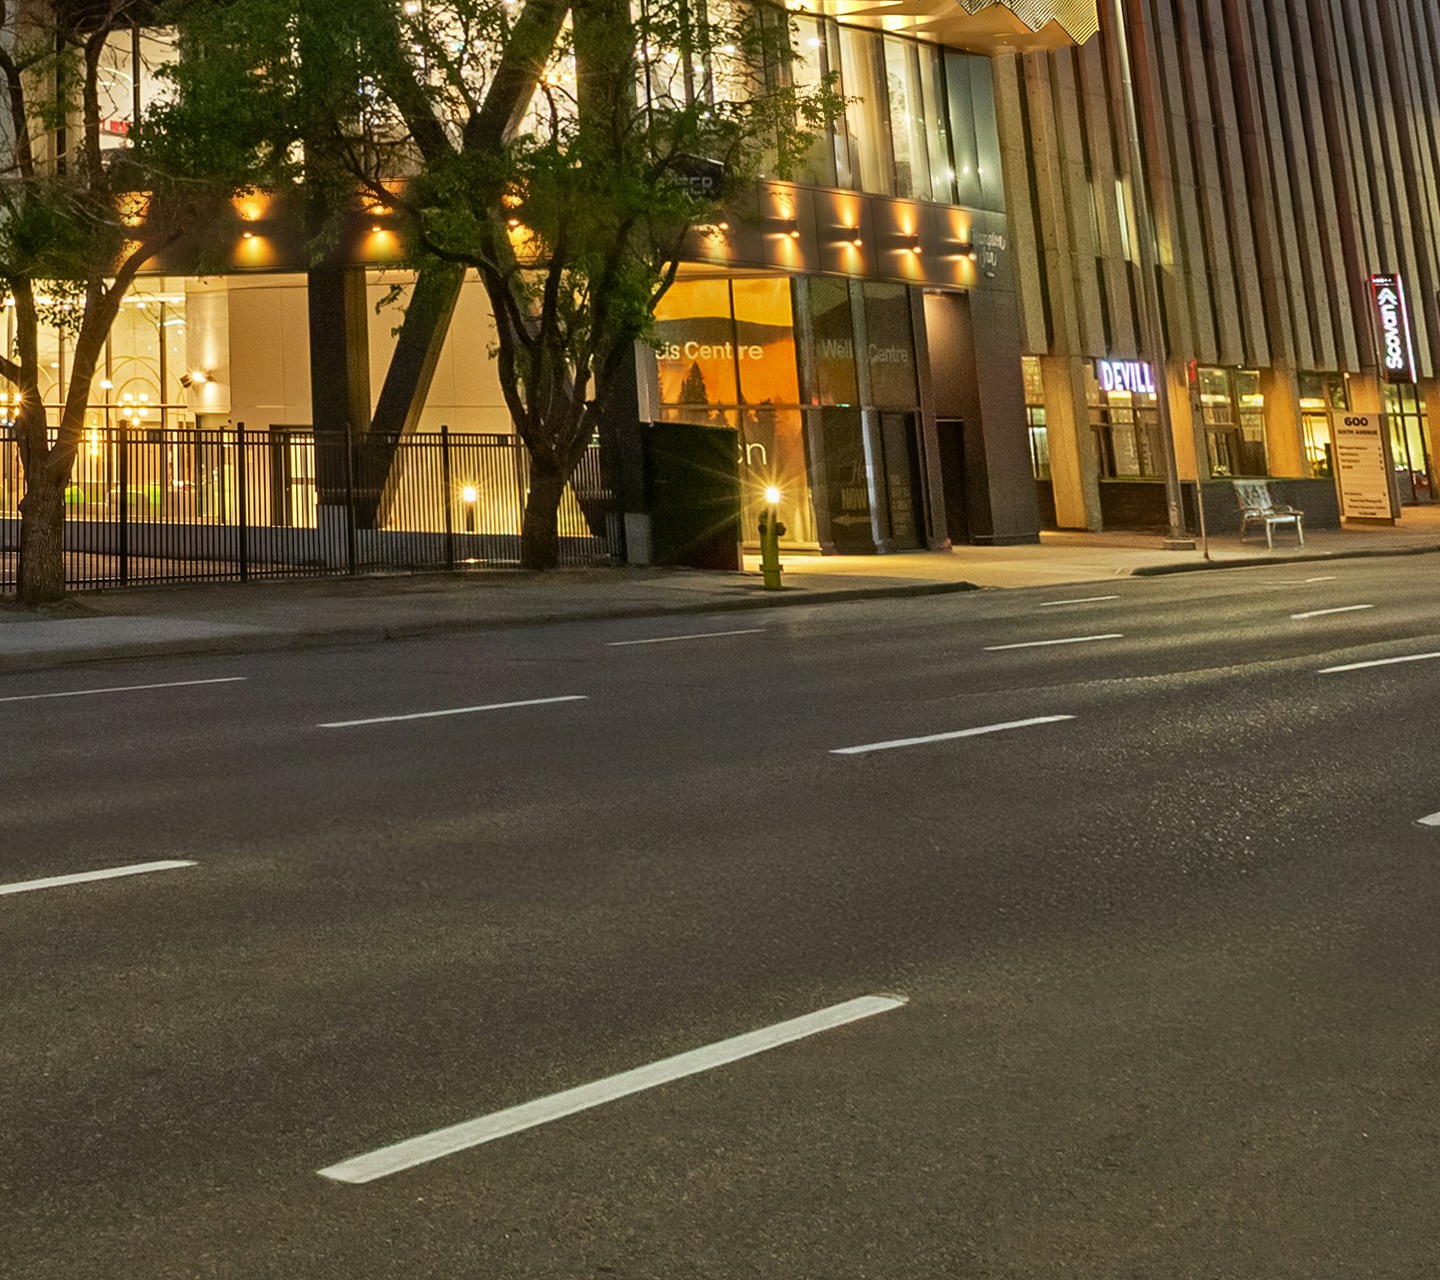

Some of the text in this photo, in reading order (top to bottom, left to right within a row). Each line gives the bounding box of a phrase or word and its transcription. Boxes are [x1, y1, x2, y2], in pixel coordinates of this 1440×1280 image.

[1381, 304, 1404, 369] Scovan
[685, 341, 764, 361] Centre
[1101, 360, 1155, 393] DEVILL
[1344, 417, 1369, 427] 600
